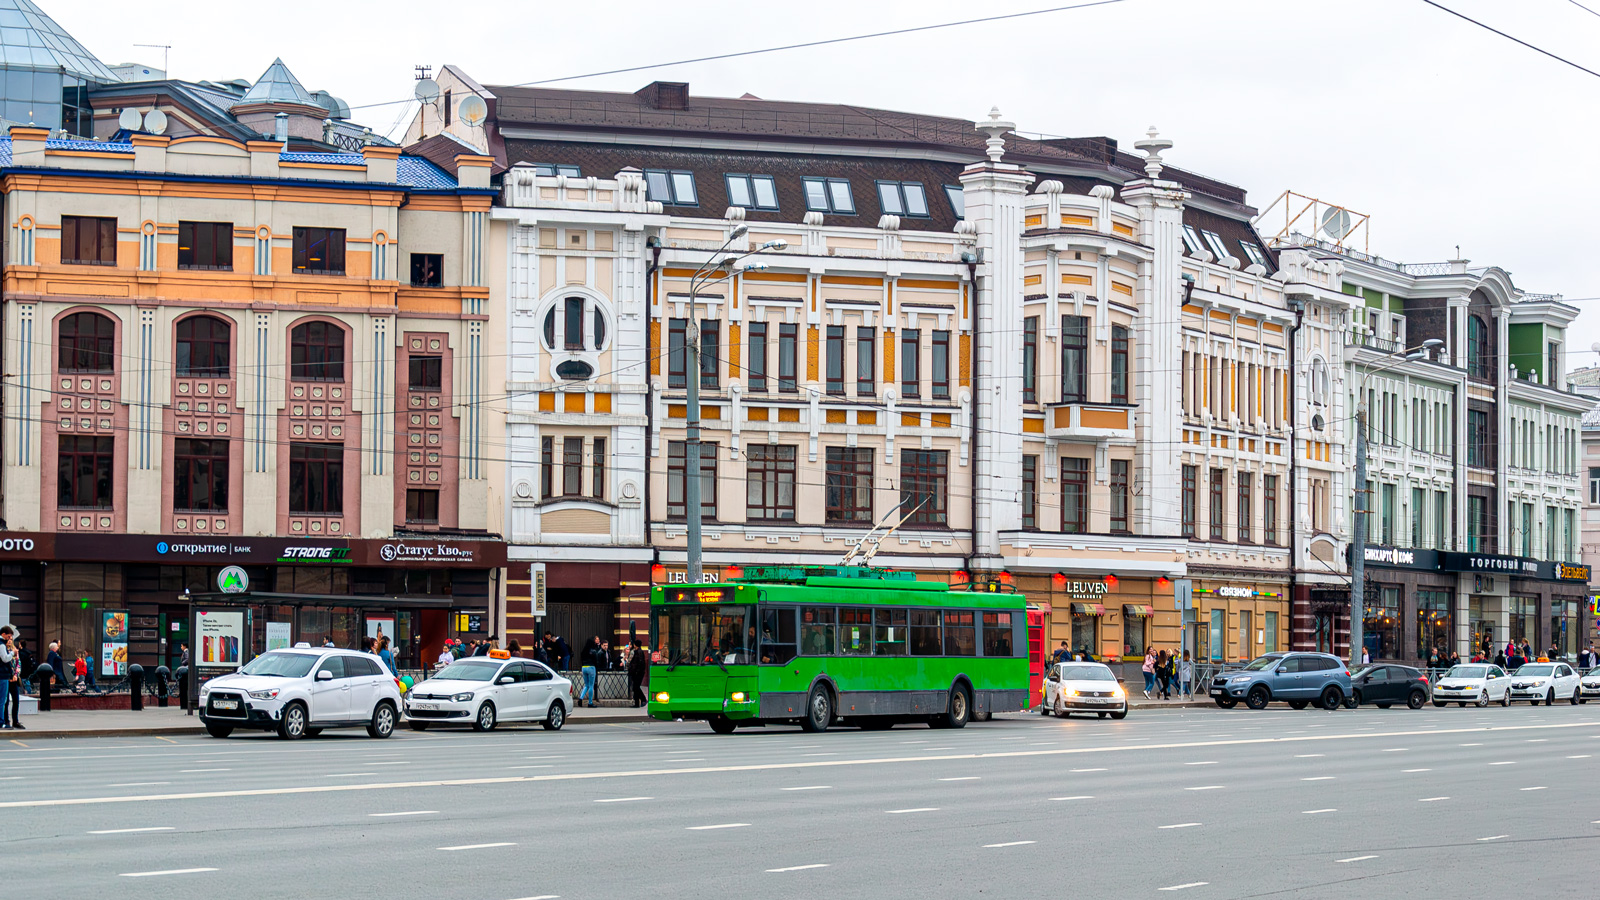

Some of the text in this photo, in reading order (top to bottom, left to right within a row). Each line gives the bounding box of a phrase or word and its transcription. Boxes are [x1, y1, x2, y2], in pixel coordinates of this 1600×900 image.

[0, 538, 34, 551] ОТО
[171, 543, 227, 555] открытие
[282, 547, 352, 558] STRONGFIT
[396, 544, 434, 558] Статус
[1470, 557, 1519, 570] ТОРГОВЫЙ
[668, 572, 719, 584] LEUEN
[537, 573, 545, 609] ПЕРЕХОД
[1066, 581, 1108, 593] LEUVEN
[1220, 586, 1252, 597] СВЯЗНОЙ
